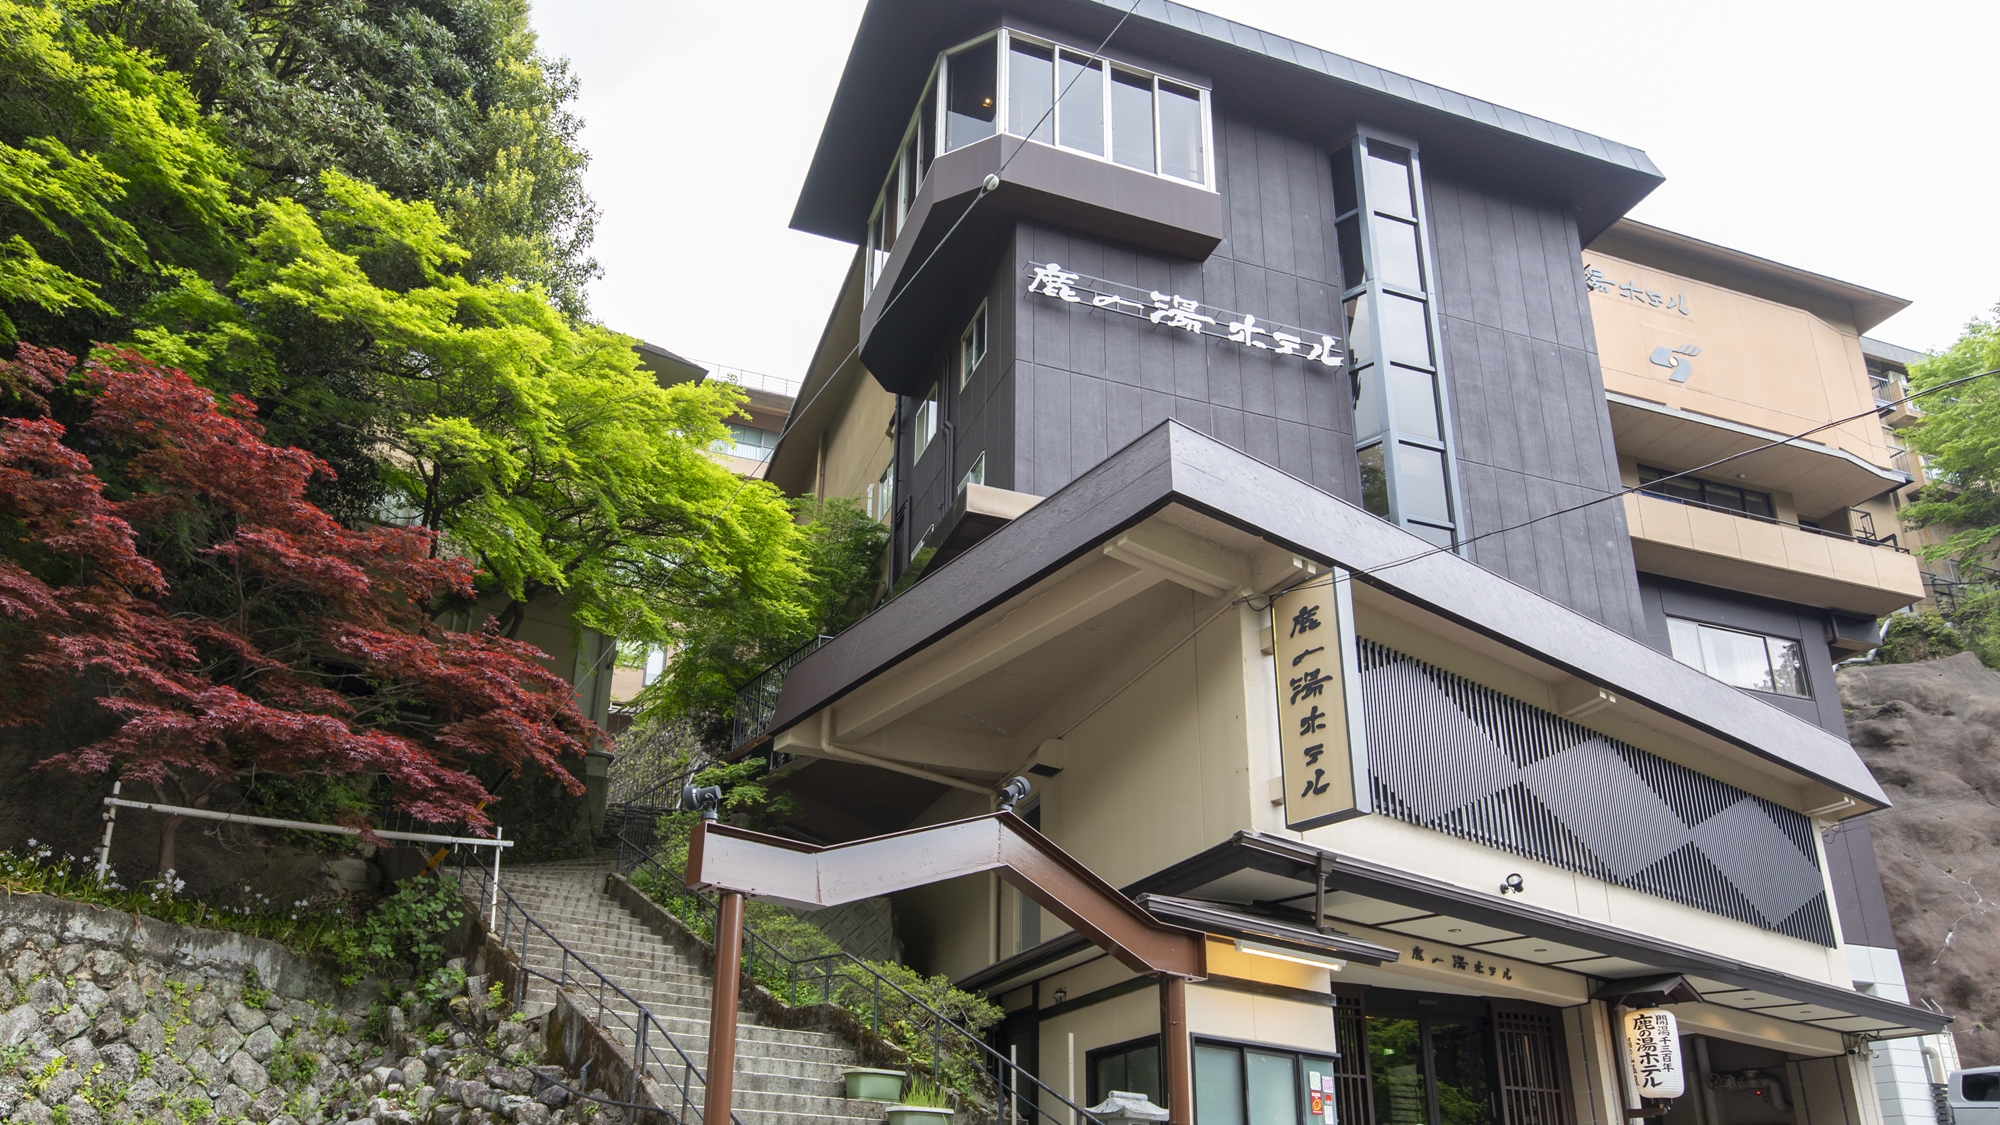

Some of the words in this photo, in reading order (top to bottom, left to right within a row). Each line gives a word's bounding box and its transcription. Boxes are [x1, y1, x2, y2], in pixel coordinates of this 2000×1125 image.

[1633, 1014, 1663, 1088] 鹿の湯ホテル
[1655, 1014, 1674, 1072] 開湯千三百年
